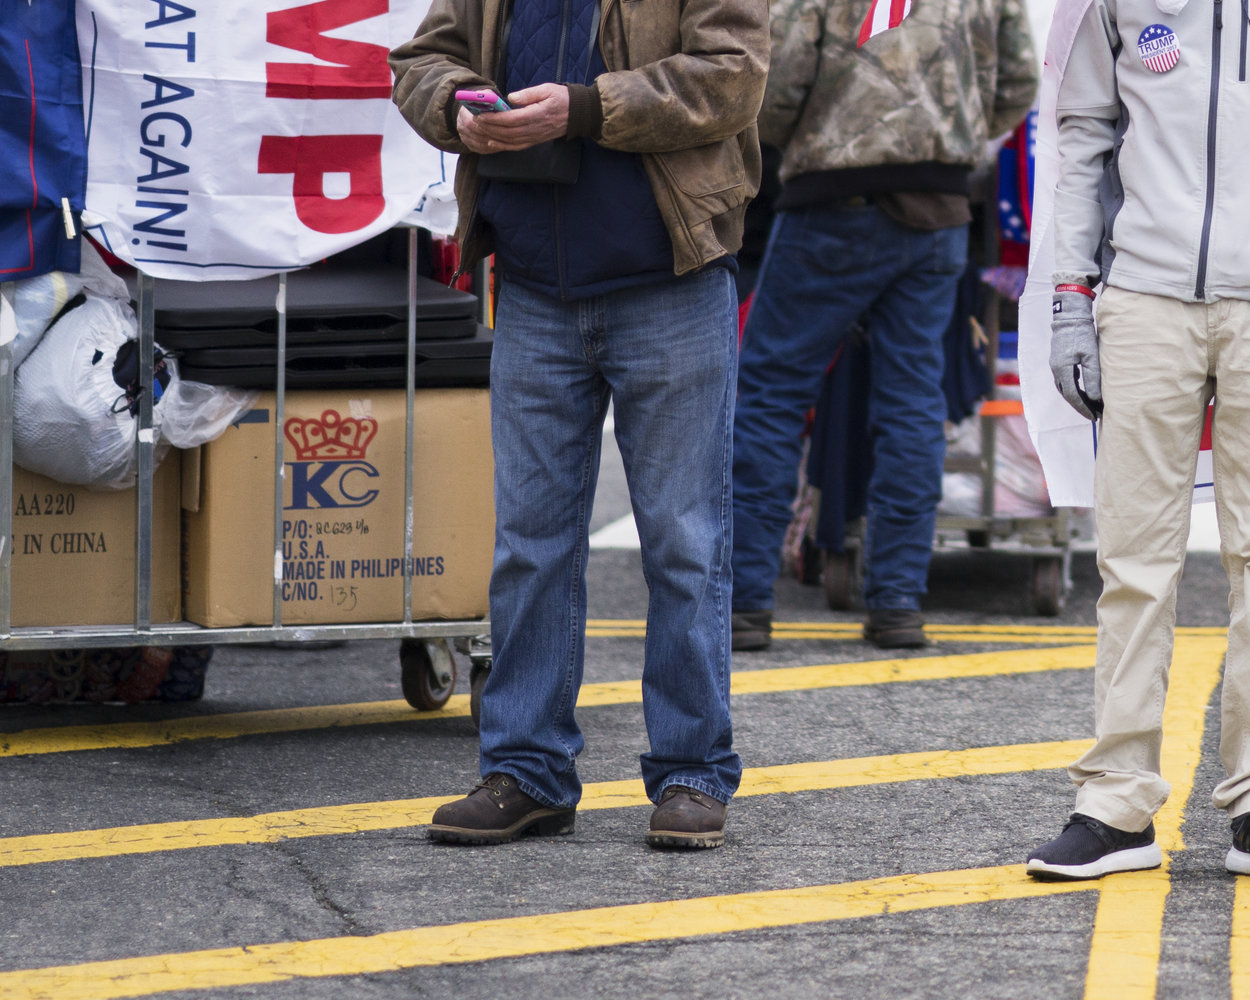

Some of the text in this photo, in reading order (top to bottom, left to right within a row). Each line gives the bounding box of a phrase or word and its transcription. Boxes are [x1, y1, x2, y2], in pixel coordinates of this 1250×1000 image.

[1138, 34, 1175, 55] TRUMP
[1141, 47, 1166, 60] PRESIDENT
[131, 73, 195, 252] AGAIN!
[283, 459, 380, 511] KC
[14, 492, 76, 517] AA220
[282, 519, 313, 540] P/O:
[23, 533, 43, 555] IN
[50, 531, 107, 555] CHINA
[282, 540, 331, 561] U.S.A.
[282, 560, 326, 581] MADE
[330, 559, 346, 580] IN
[282, 581, 359, 612] C/NO. 135
